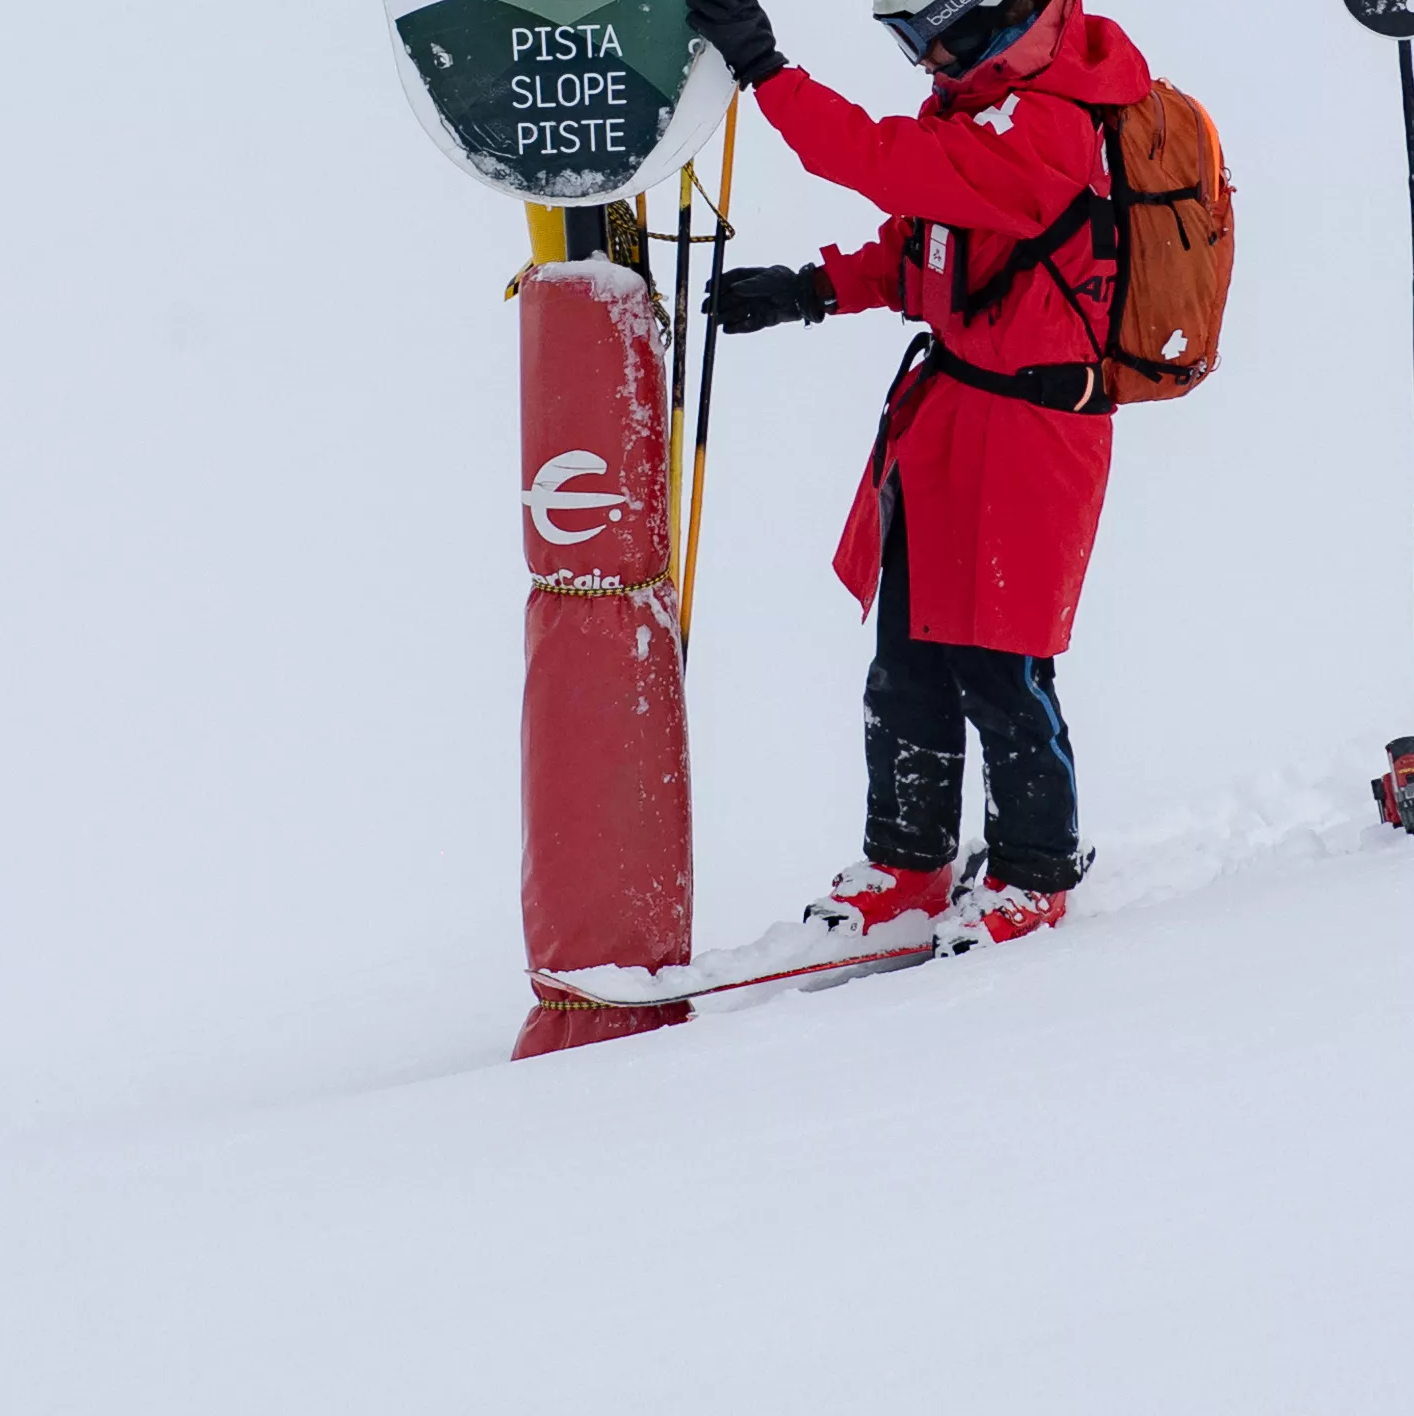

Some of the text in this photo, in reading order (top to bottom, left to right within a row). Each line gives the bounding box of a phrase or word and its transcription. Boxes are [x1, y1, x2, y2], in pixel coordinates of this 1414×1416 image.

[511, 24, 623, 61] PISTA
[511, 72, 627, 109] SLOPE
[517, 119, 626, 155] PISTE
